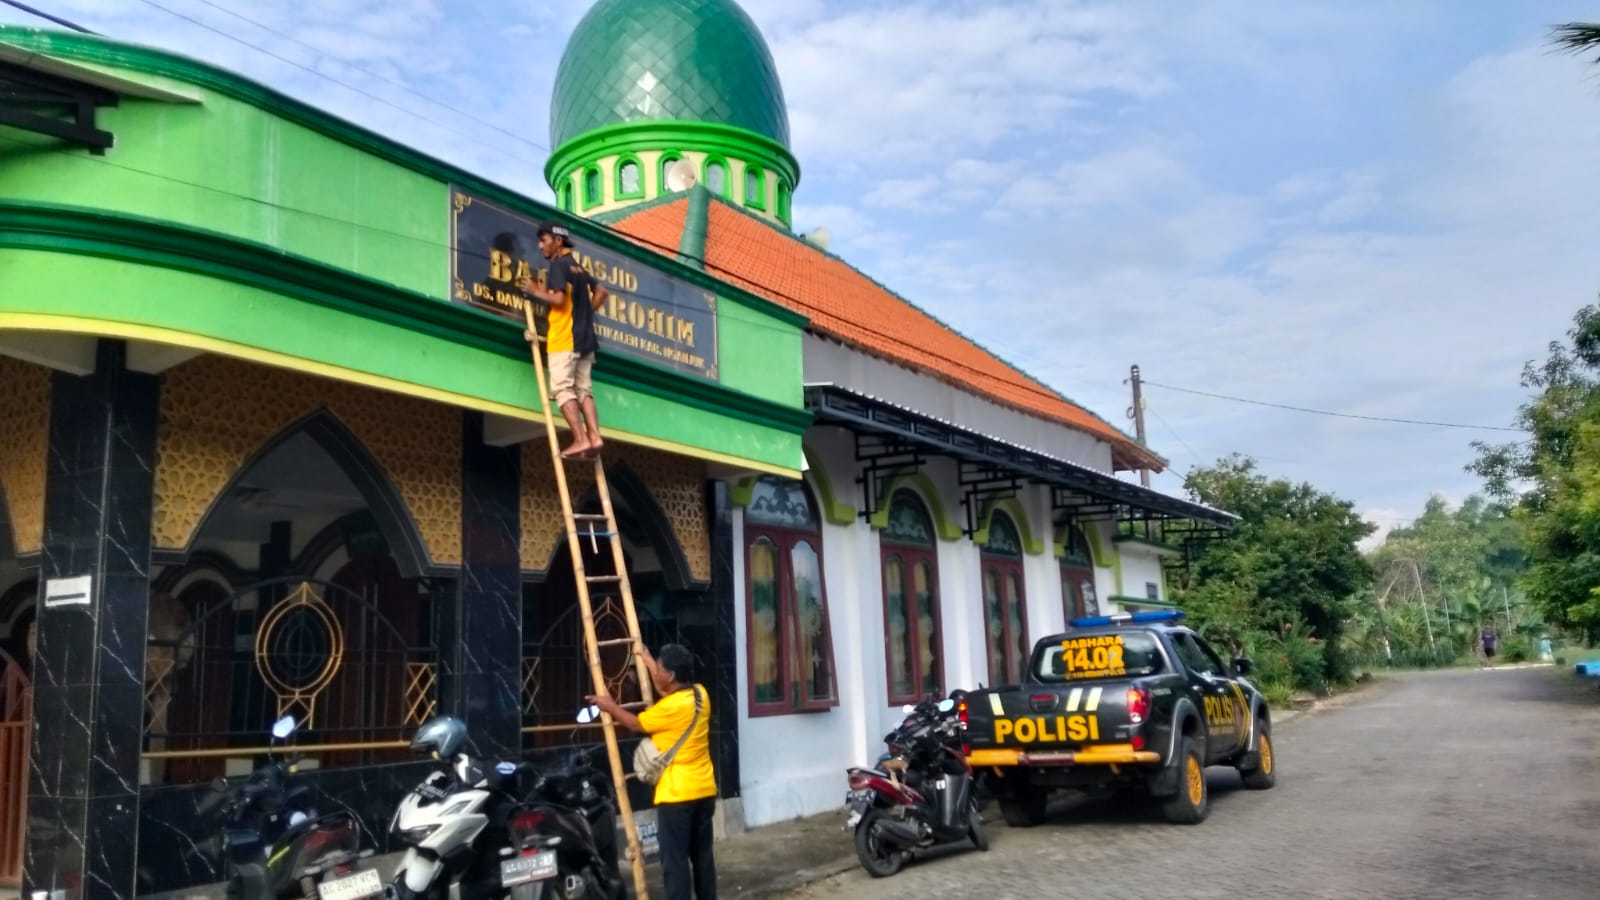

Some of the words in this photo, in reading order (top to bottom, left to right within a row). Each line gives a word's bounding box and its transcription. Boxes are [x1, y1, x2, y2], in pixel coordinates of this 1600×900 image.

[1062, 635, 1123, 649] SABHARA
[1063, 645, 1125, 671] 14.02
[1203, 695, 1234, 725] POLISI
[994, 714, 1099, 744] POLISI
